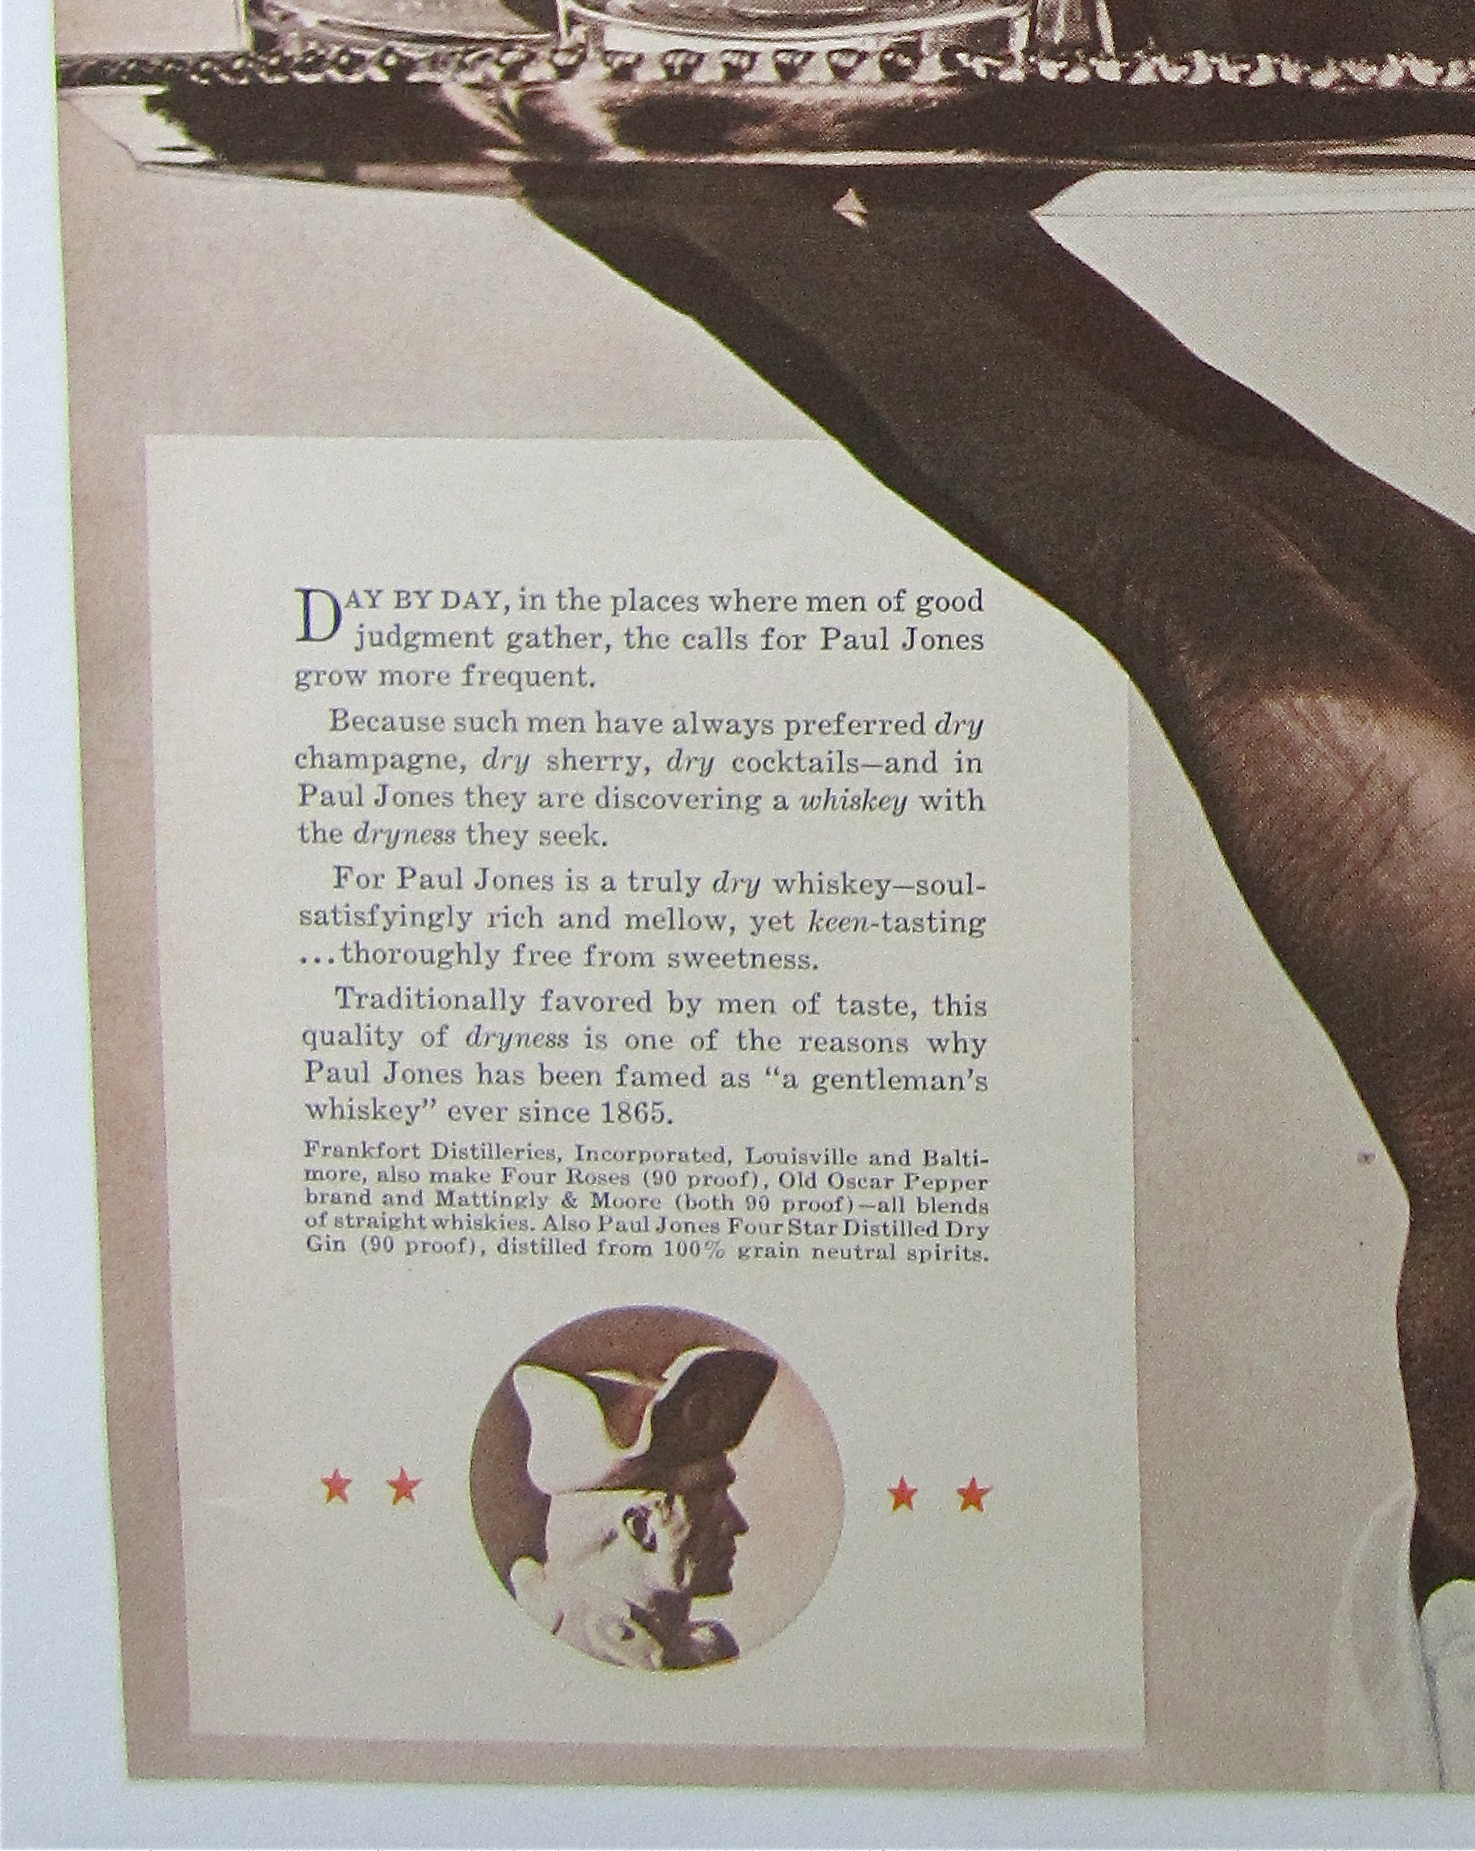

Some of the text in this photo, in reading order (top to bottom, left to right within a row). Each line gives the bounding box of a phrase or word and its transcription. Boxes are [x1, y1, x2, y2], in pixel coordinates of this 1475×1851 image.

[295, 587, 984, 642] DAY BY DAY, in the places where men of good
[354, 623, 983, 654] judgment gather, the calls for Paul Jones
[295, 663, 595, 692] grow more frequent.
[329, 708, 984, 741] Because such men have always preferred dry
[295, 745, 466, 775] champagne,
[483, 746, 529, 775] dry
[548, 747, 650, 776] sherry,
[667, 748, 714, 777] dry
[955, 750, 982, 773] in
[299, 783, 985, 816] Paul Jones they are discovering a whiskey with
[298, 820, 607, 850] the dryness they seek.
[333, 865, 385, 889] For
[397, 866, 462, 889] Paul
[474, 868, 553, 891] Jones
[567, 868, 588, 891] is
[601, 876, 616, 891] a
[628, 870, 701, 898] truly
[713, 870, 760, 899] dry
[300, 903, 986, 938] satisfyingly rich and mellow, yet keen-tasting
[513, 943, 571, 966] free
[584, 944, 654, 967] from
[668, 948, 818, 970] sweetness.
[335, 986, 986, 1021] Traditionally favored by men of taste, this
[303, 1023, 986, 1059] quality of dryness is one of the reasons why
[304, 1060, 368, 1083] Paul
[384, 1061, 462, 1084] Jones
[477, 1062, 524, 1085] has
[538, 1063, 600, 1085] been
[616, 1064, 706, 1087] famed
[721, 1072, 750, 1088] as
[448, 1106, 508, 1121] ever
[519, 1100, 589, 1123] since
[602, 1102, 672, 1124] 1865.
[304, 1140, 988, 1167] Frankfort Distilleries, Incorporated, Louisville and Balti-
[305, 1165, 988, 1193] more, also make Four Roses (90 proof), Old Oscar Pepper
[307, 1188, 370, 1205] brand
[383, 1189, 423, 1206] and
[436, 1190, 548, 1210] Mattingly
[591, 1192, 661, 1208] Moore
[676, 1194, 733, 1210] (both
[746, 1195, 769, 1211] 90
[916, 1196, 988, 1214] blends
[305, 1211, 328, 1228] of
[335, 1211, 426, 1230] straight
[432, 1214, 535, 1231] whiskies.
[543, 1215, 590, 1231] Also
[598, 1215, 648, 1232] Paul
[656, 1217, 719, 1233] Jones
[843, 1219, 938, 1237] Distilled
[946, 1221, 989, 1240] Dry
[307, 1234, 345, 1252] Gin
[361, 1236, 393, 1252] (90
[407, 1236, 485, 1256] proof),
[497, 1236, 585, 1255] distilled
[598, 1239, 652, 1256] from
[738, 1242, 798, 1259] grain
[813, 1243, 894, 1260] neutral
[908, 1244, 988, 1263] spirits.
